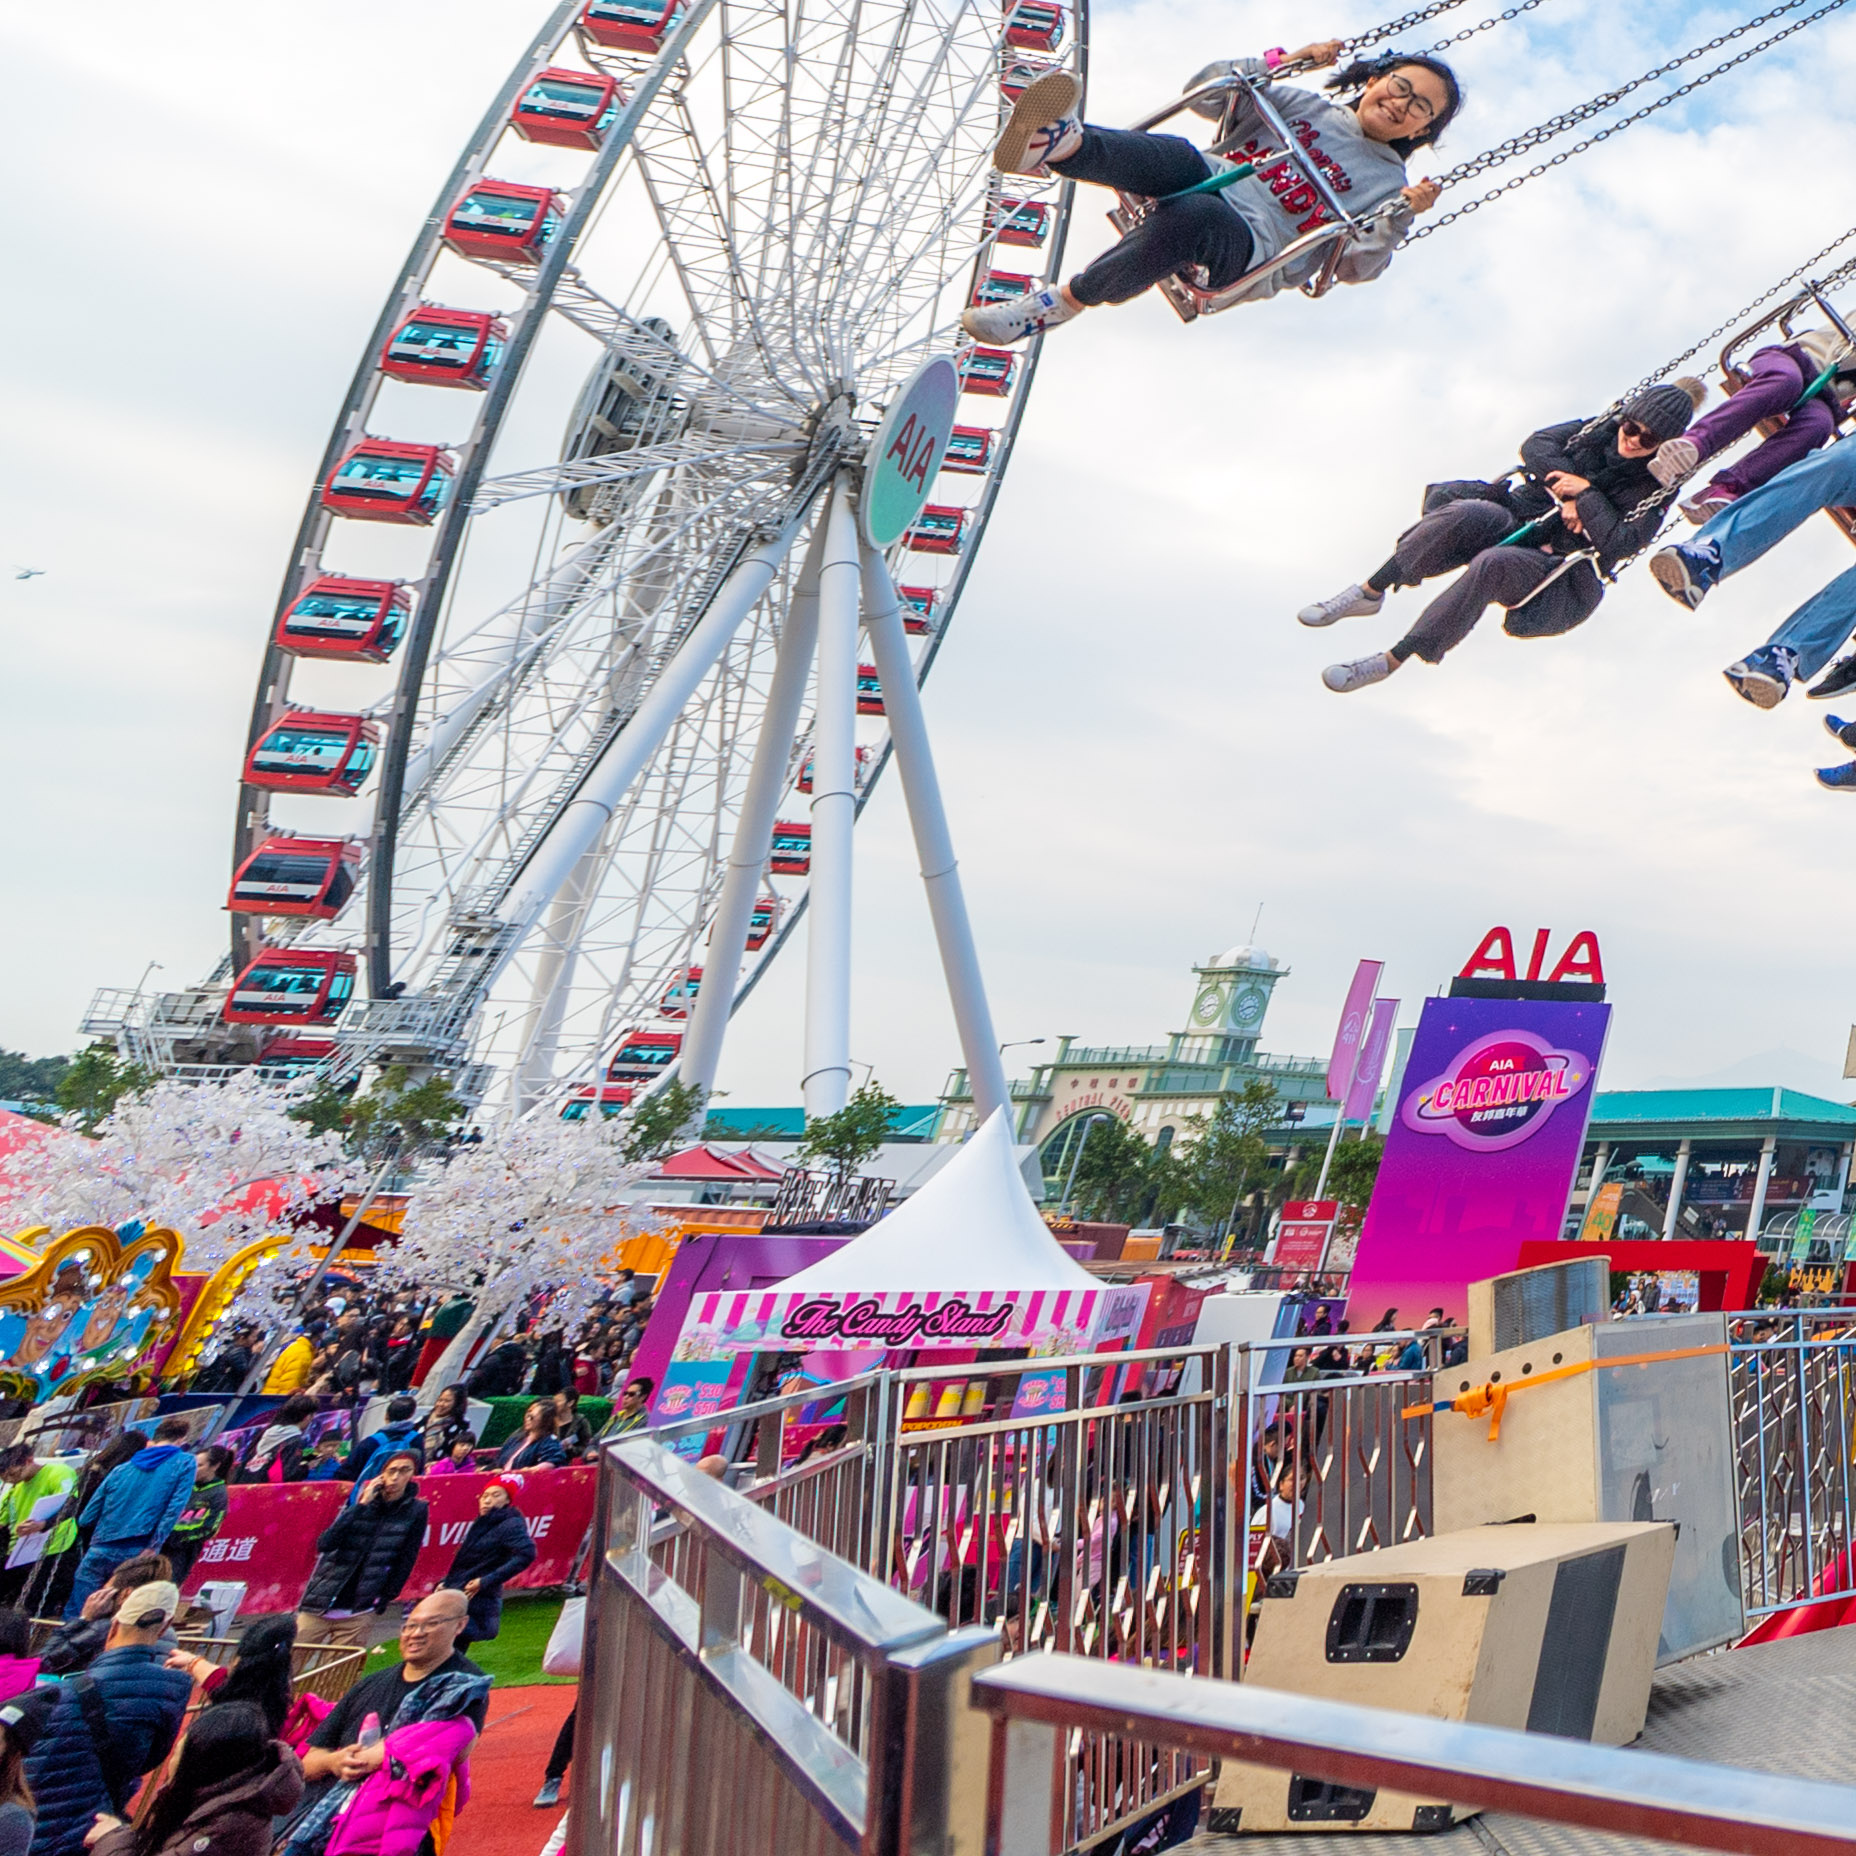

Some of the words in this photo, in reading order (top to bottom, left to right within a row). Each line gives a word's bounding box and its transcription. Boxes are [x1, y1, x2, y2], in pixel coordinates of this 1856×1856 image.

[886, 412, 935, 495] AIA
[363, 480, 385, 489] AIA
[317, 618, 340, 628] AIA
[284, 754, 308, 763] AIA
[265, 884, 289, 893] AIA
[1458, 926, 1604, 984] AIA
[263, 993, 286, 1002] AIA
[1488, 1059, 1515, 1072] AIA
[1431, 1069, 1571, 1112] CARNIVAL
[1056, 1092, 1104, 1122] CENTRAL
[1108, 1095, 1131, 1121] PIER
[783, 1302, 840, 1336] The
[842, 1302, 922, 1344] Candy
[924, 1303, 1010, 1336] Stand
[199, 1536, 258, 1563] 通道
